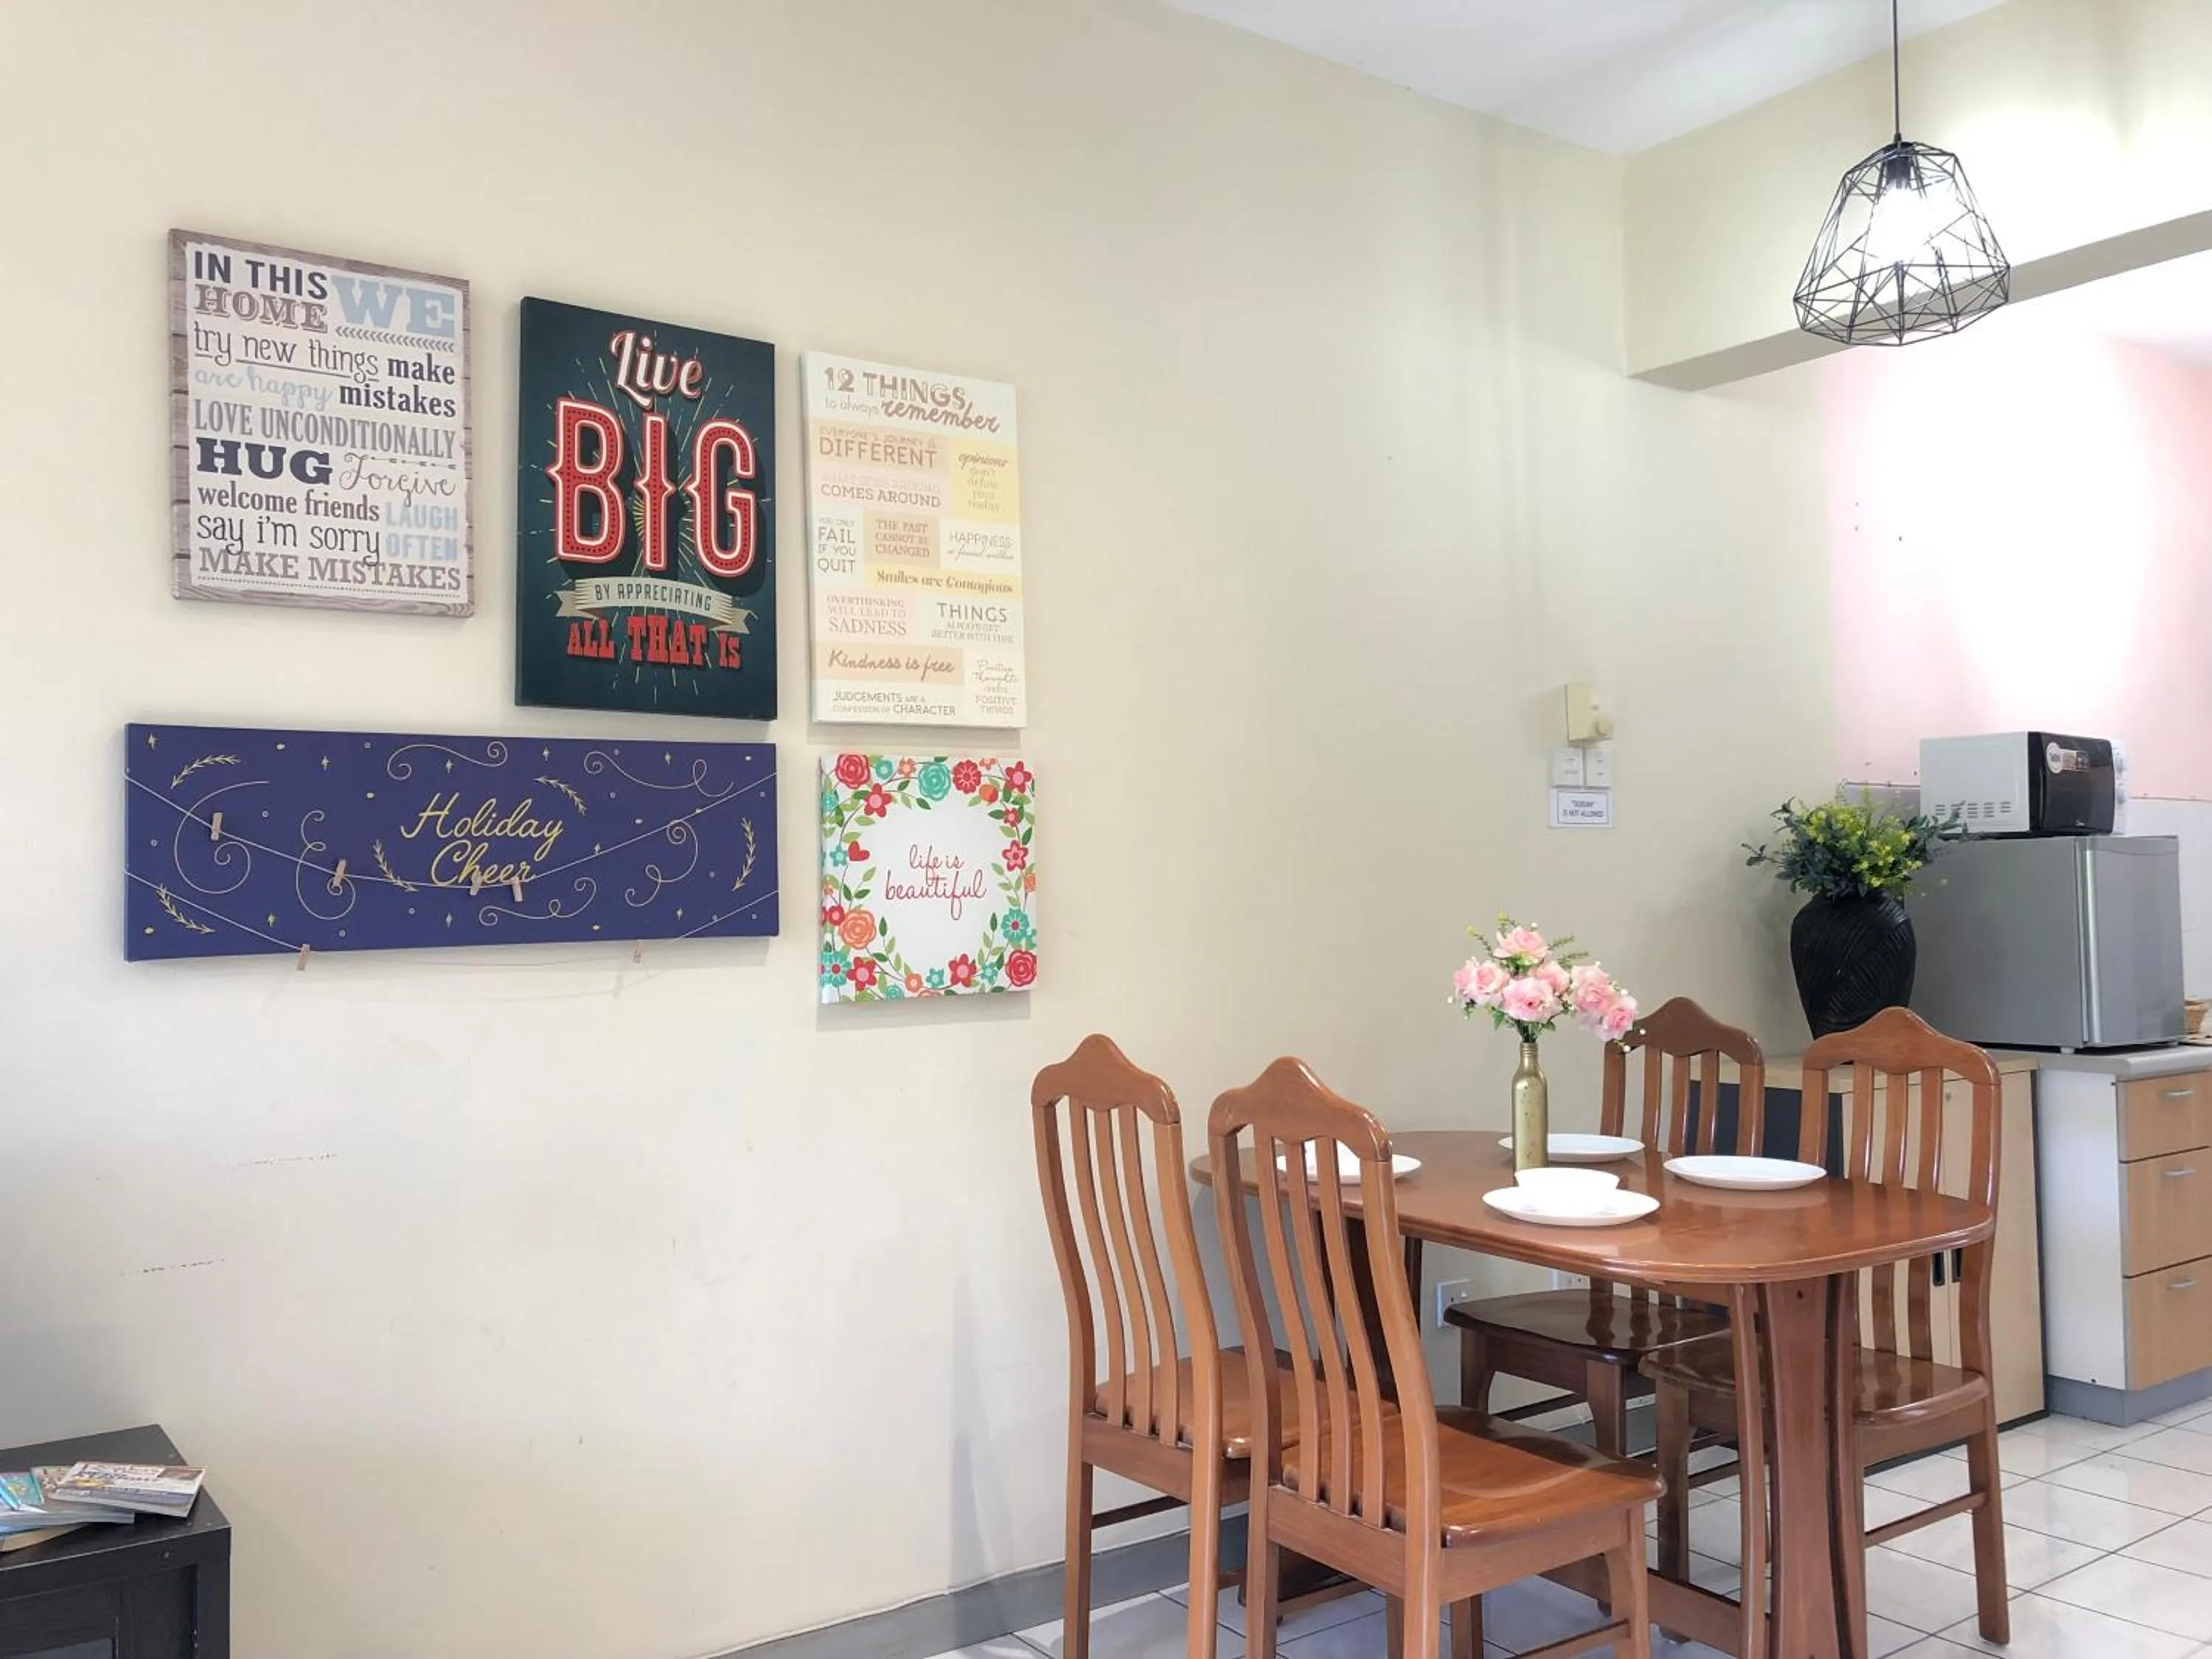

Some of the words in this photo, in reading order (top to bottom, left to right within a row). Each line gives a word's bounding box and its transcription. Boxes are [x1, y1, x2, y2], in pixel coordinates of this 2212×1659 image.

[195, 251, 231, 283] IN
[246, 260, 328, 299] THIS
[195, 284, 328, 334] HOME
[330, 275, 455, 338] WE
[195, 321, 232, 366] try
[242, 335, 296, 364] new
[310, 339, 378, 383] things
[388, 353, 455, 384] make
[610, 330, 703, 408] Live
[195, 368, 240, 387] are
[247, 366, 333, 411] happy
[340, 385, 456, 417] mistakes
[824, 366, 855, 392] 12
[863, 372, 966, 411] THINGS
[826, 397, 837, 408] to
[841, 394, 880, 418] always
[881, 400, 1000, 433] remember
[195, 399, 252, 435] LOVE
[260, 407, 456, 459] UNCONDITIONALLY
[196, 437, 332, 485] HUG
[819, 437, 937, 468] DIFFERENT
[339, 453, 456, 508] Forgive
[546, 397, 756, 577] BIG
[821, 484, 874, 501] COMES
[877, 489, 940, 507] AROUND
[198, 481, 296, 512] welcome
[305, 490, 380, 521] friends
[384, 501, 458, 532] LAUGH
[197, 515, 243, 555] say
[257, 517, 296, 546] i'm
[310, 526, 380, 566] sorry
[818, 526, 855, 543] FAIL
[875, 519, 897, 532] THE
[902, 521, 929, 534] PAST
[875, 532, 916, 545] CANNOT
[950, 531, 1012, 549] HAPPINESS
[385, 533, 457, 562] OFTEN
[818, 544, 828, 554] IF
[834, 546, 856, 557] YOU
[875, 544, 930, 558] CHANGED
[200, 548, 299, 579] MAKE
[308, 557, 460, 590] MISTAKES
[817, 558, 856, 574] QUIT
[877, 570, 918, 584] Smiles
[922, 577, 942, 588] are
[946, 577, 1012, 594] Contagious
[595, 584, 610, 600] BY
[618, 583, 712, 611] APPRECIATING
[827, 594, 904, 608] OVERTHINKING
[936, 602, 1007, 623] THINGS
[829, 616, 907, 636] SADNESS
[567, 617, 614, 658] ALL
[628, 616, 709, 665] THAT
[719, 631, 741, 669] IS
[829, 649, 902, 669] Kindness
[905, 656, 919, 670] is
[921, 655, 955, 682] free
[832, 690, 902, 703] JUDGEMENTS
[893, 703, 955, 717] CHARACTER
[400, 792, 563, 861] Holiday
[431, 840, 537, 886] Cheer
[909, 844, 943, 886] life
[946, 855, 964, 869] is
[886, 869, 987, 921] beautiful
